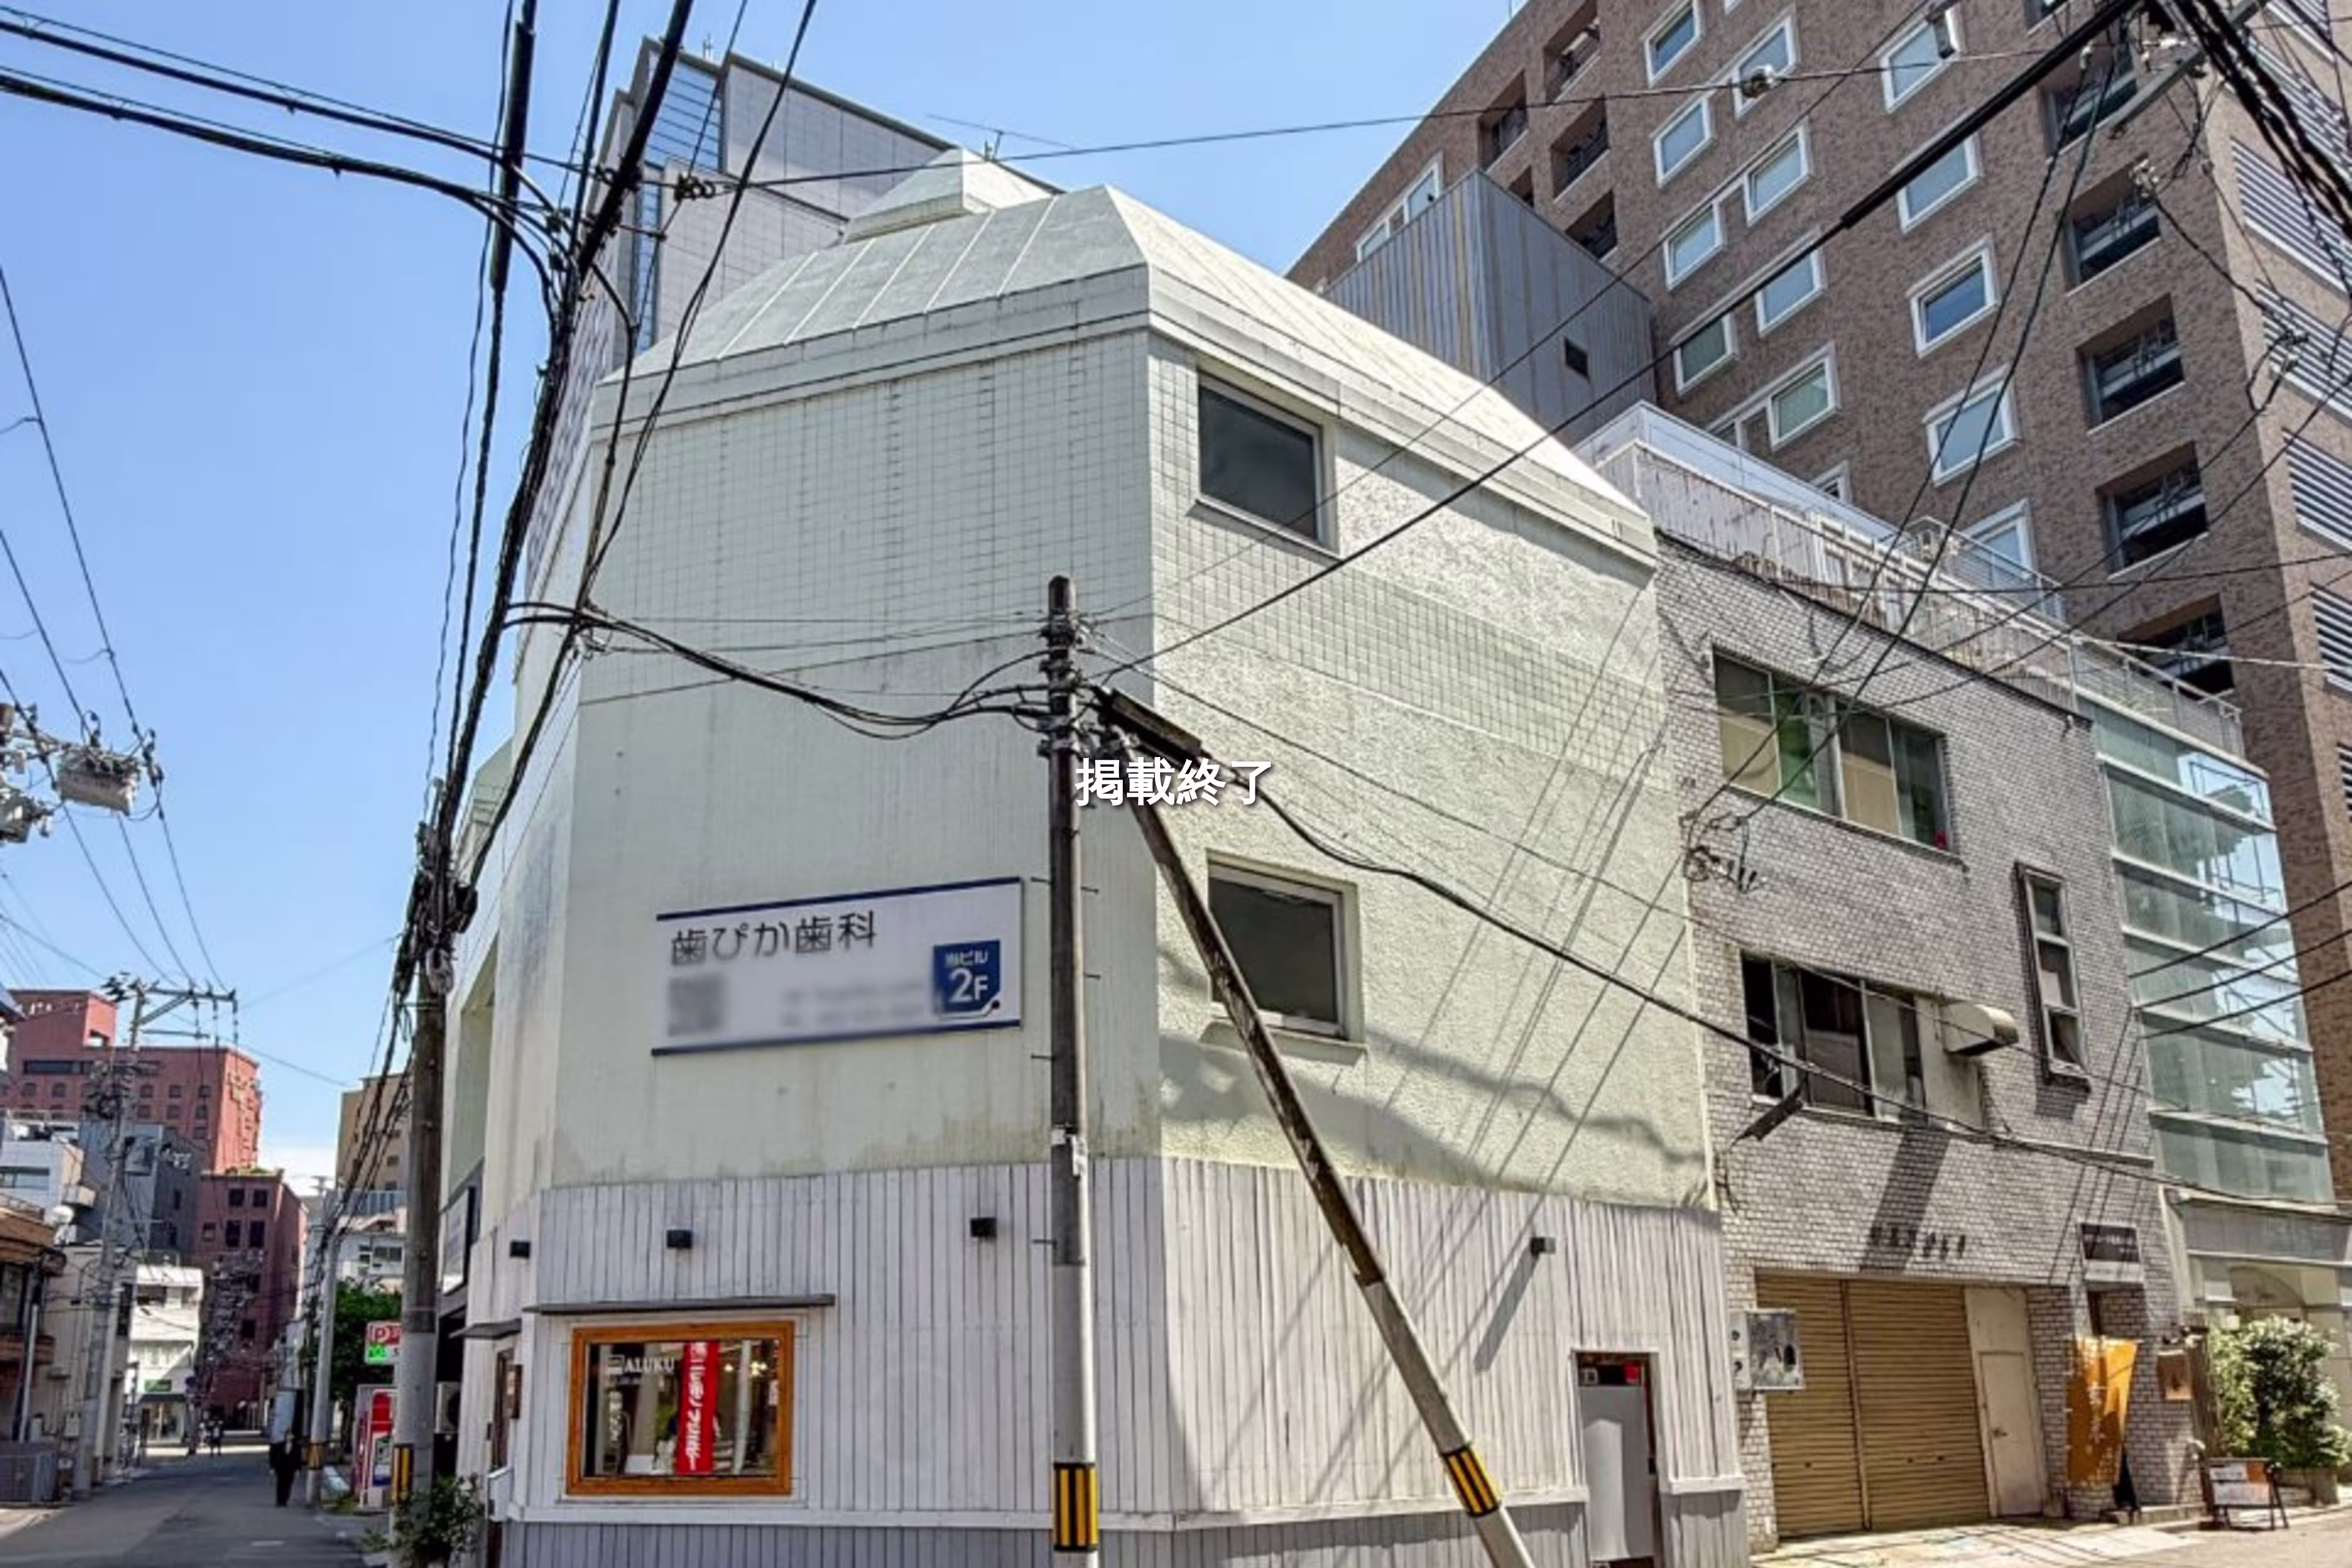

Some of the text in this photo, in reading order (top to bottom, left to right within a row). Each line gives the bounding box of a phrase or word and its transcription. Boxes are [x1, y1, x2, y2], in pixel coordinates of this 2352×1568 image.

[671, 910, 876, 966] 歯ぴか歯科
[948, 967, 988, 1003] 2F
